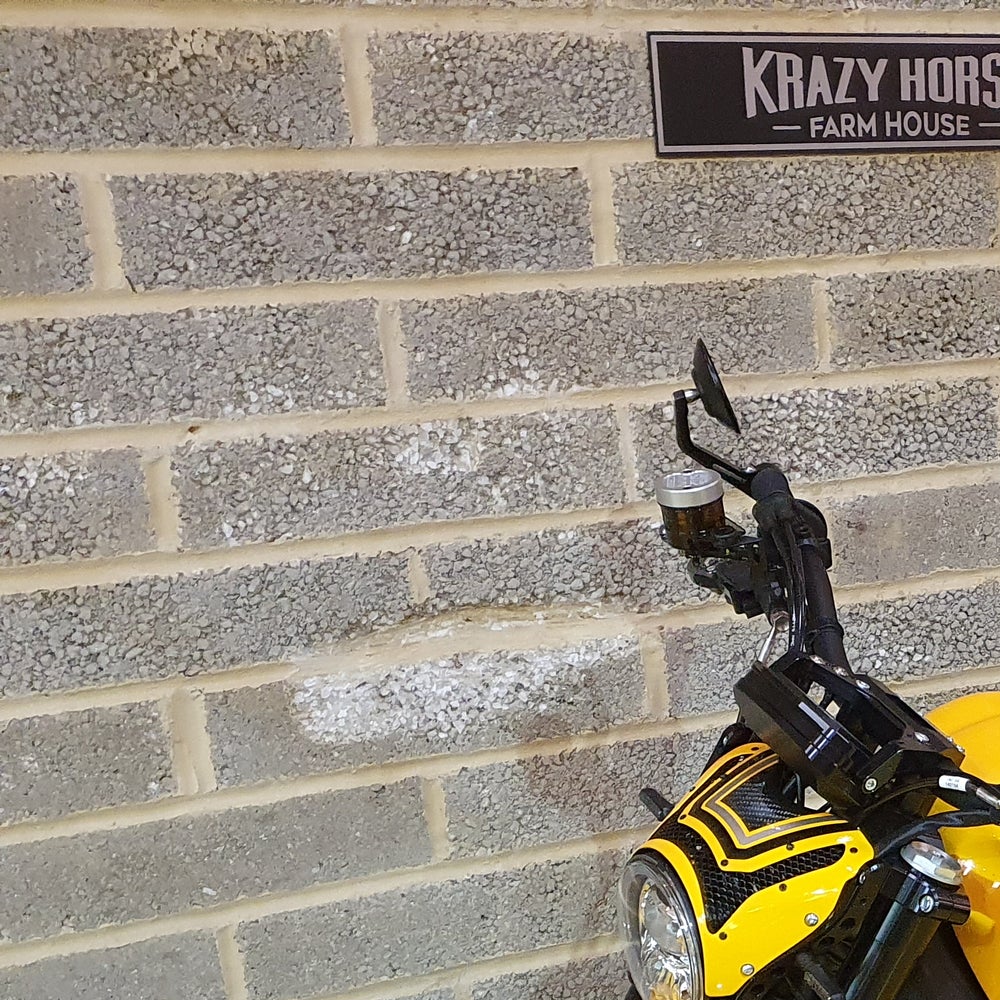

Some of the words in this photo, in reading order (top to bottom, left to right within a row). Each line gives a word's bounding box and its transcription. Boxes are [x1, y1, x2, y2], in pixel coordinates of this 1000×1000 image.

[742, 46, 889, 119] KRAZY
[809, 111, 878, 139] FARM
[885, 110, 970, 137] HOUSE
